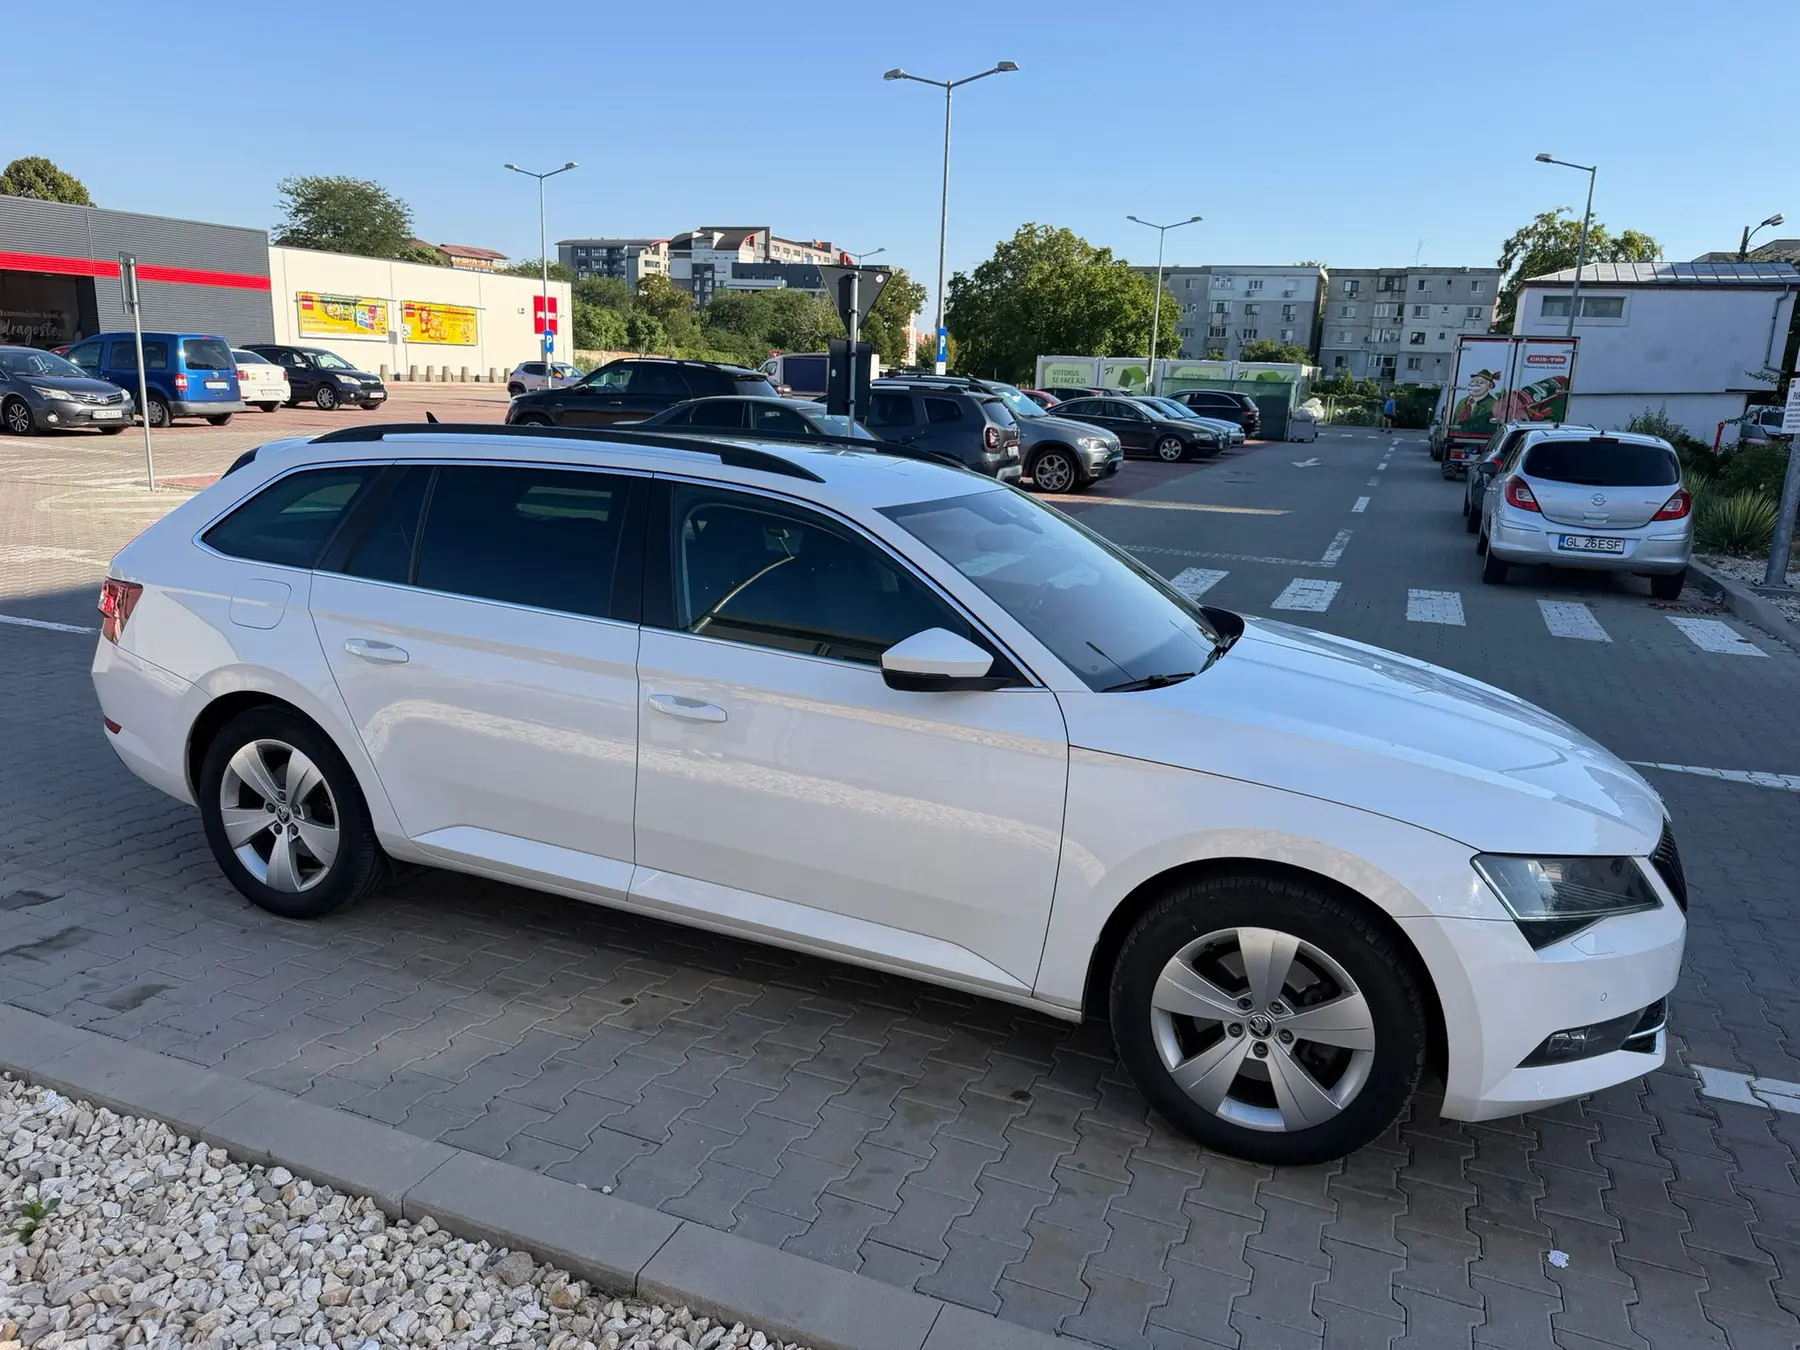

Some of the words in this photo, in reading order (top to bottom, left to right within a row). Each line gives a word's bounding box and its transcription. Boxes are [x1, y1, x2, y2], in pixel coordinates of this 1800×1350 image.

[546, 335, 553, 349] P
[940, 335, 946, 355] P
[1076, 377, 1086, 385] AZI
[1565, 537, 1580, 547] GL
[1584, 538, 1622, 550] 26ESF
